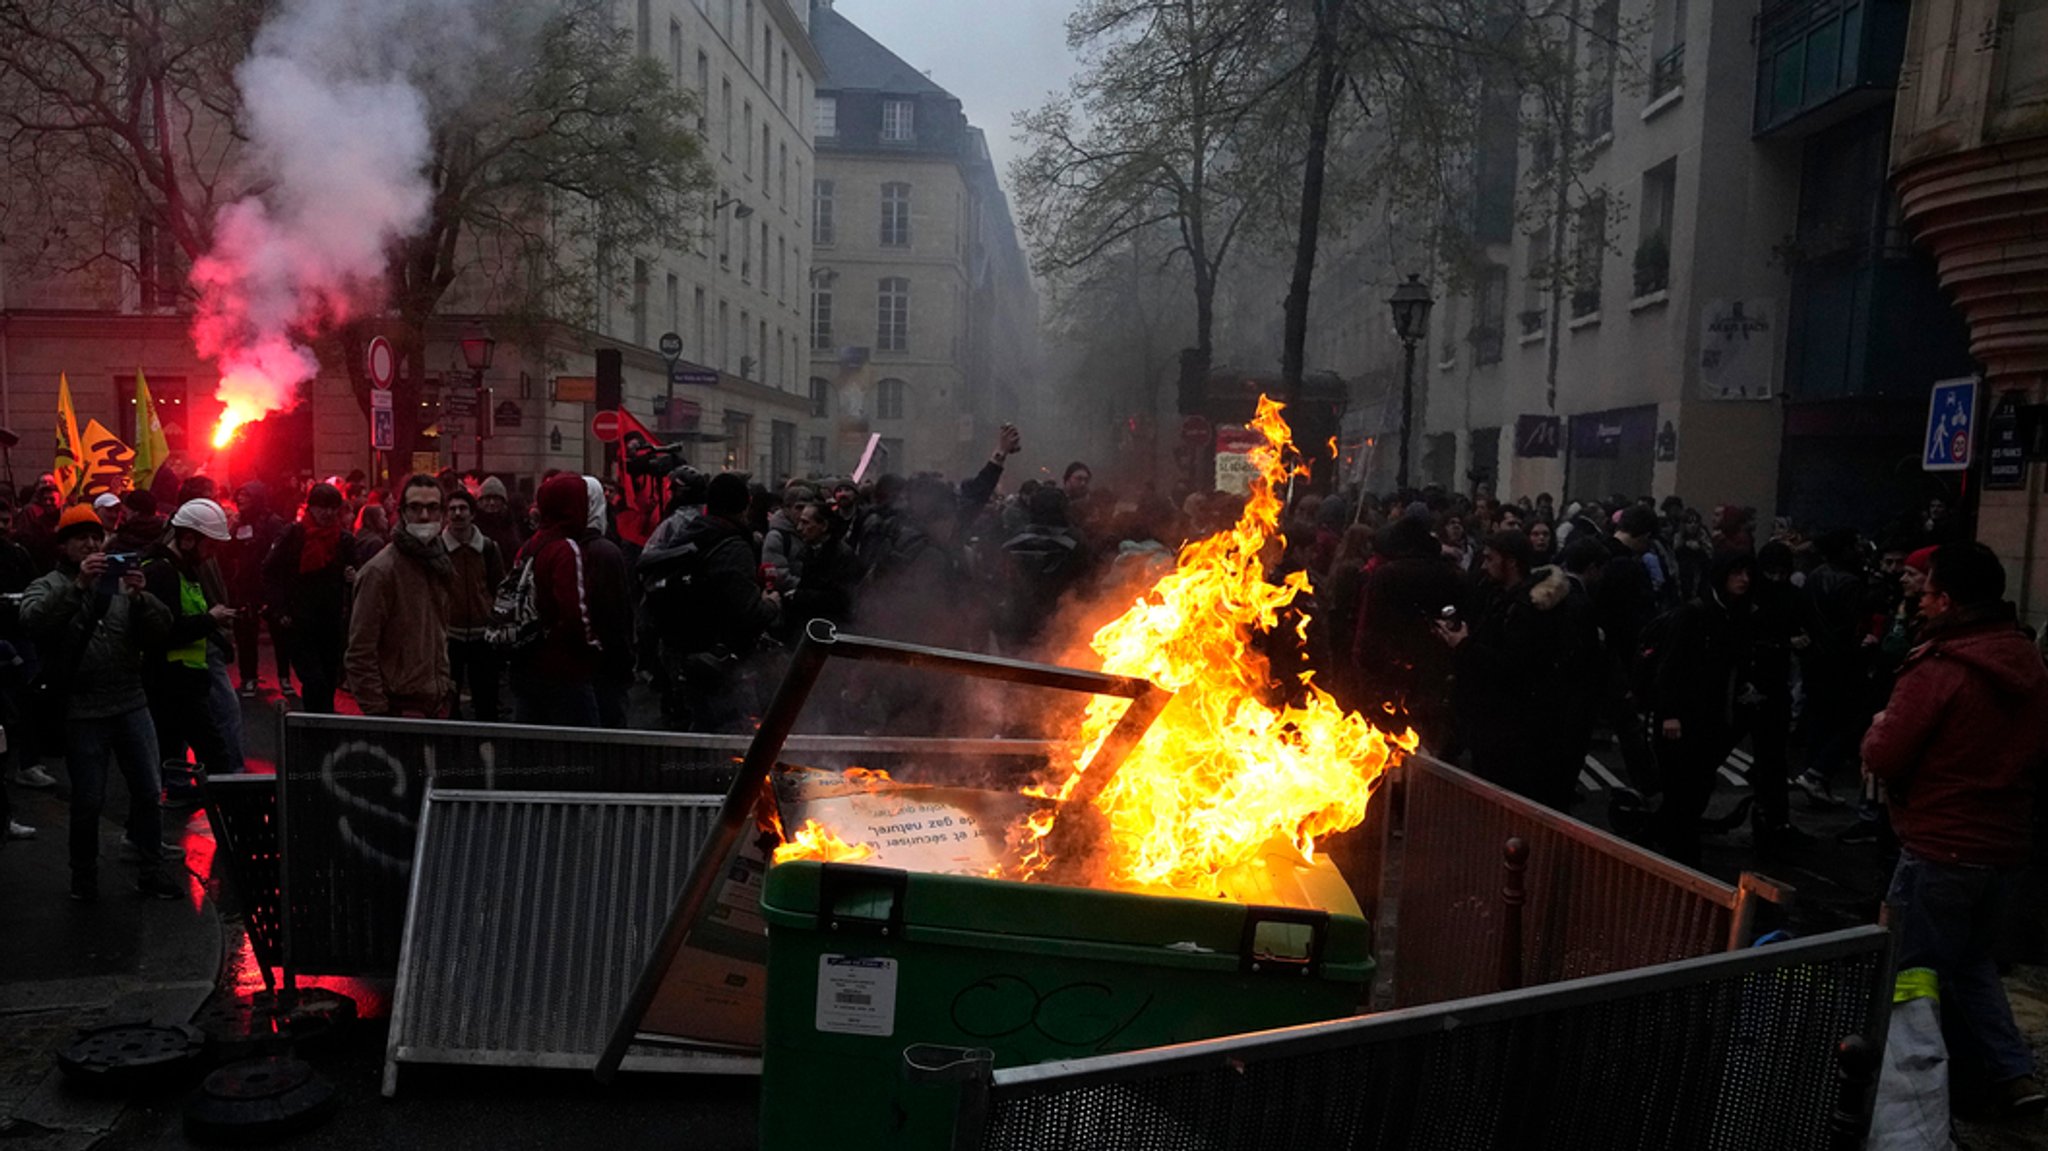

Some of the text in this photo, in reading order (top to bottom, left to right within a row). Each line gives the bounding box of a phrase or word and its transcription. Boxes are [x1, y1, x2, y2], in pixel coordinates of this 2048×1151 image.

[928, 816, 953, 829] gaz
[886, 834, 948, 848] sécuriser
[953, 831, 968, 842] et
